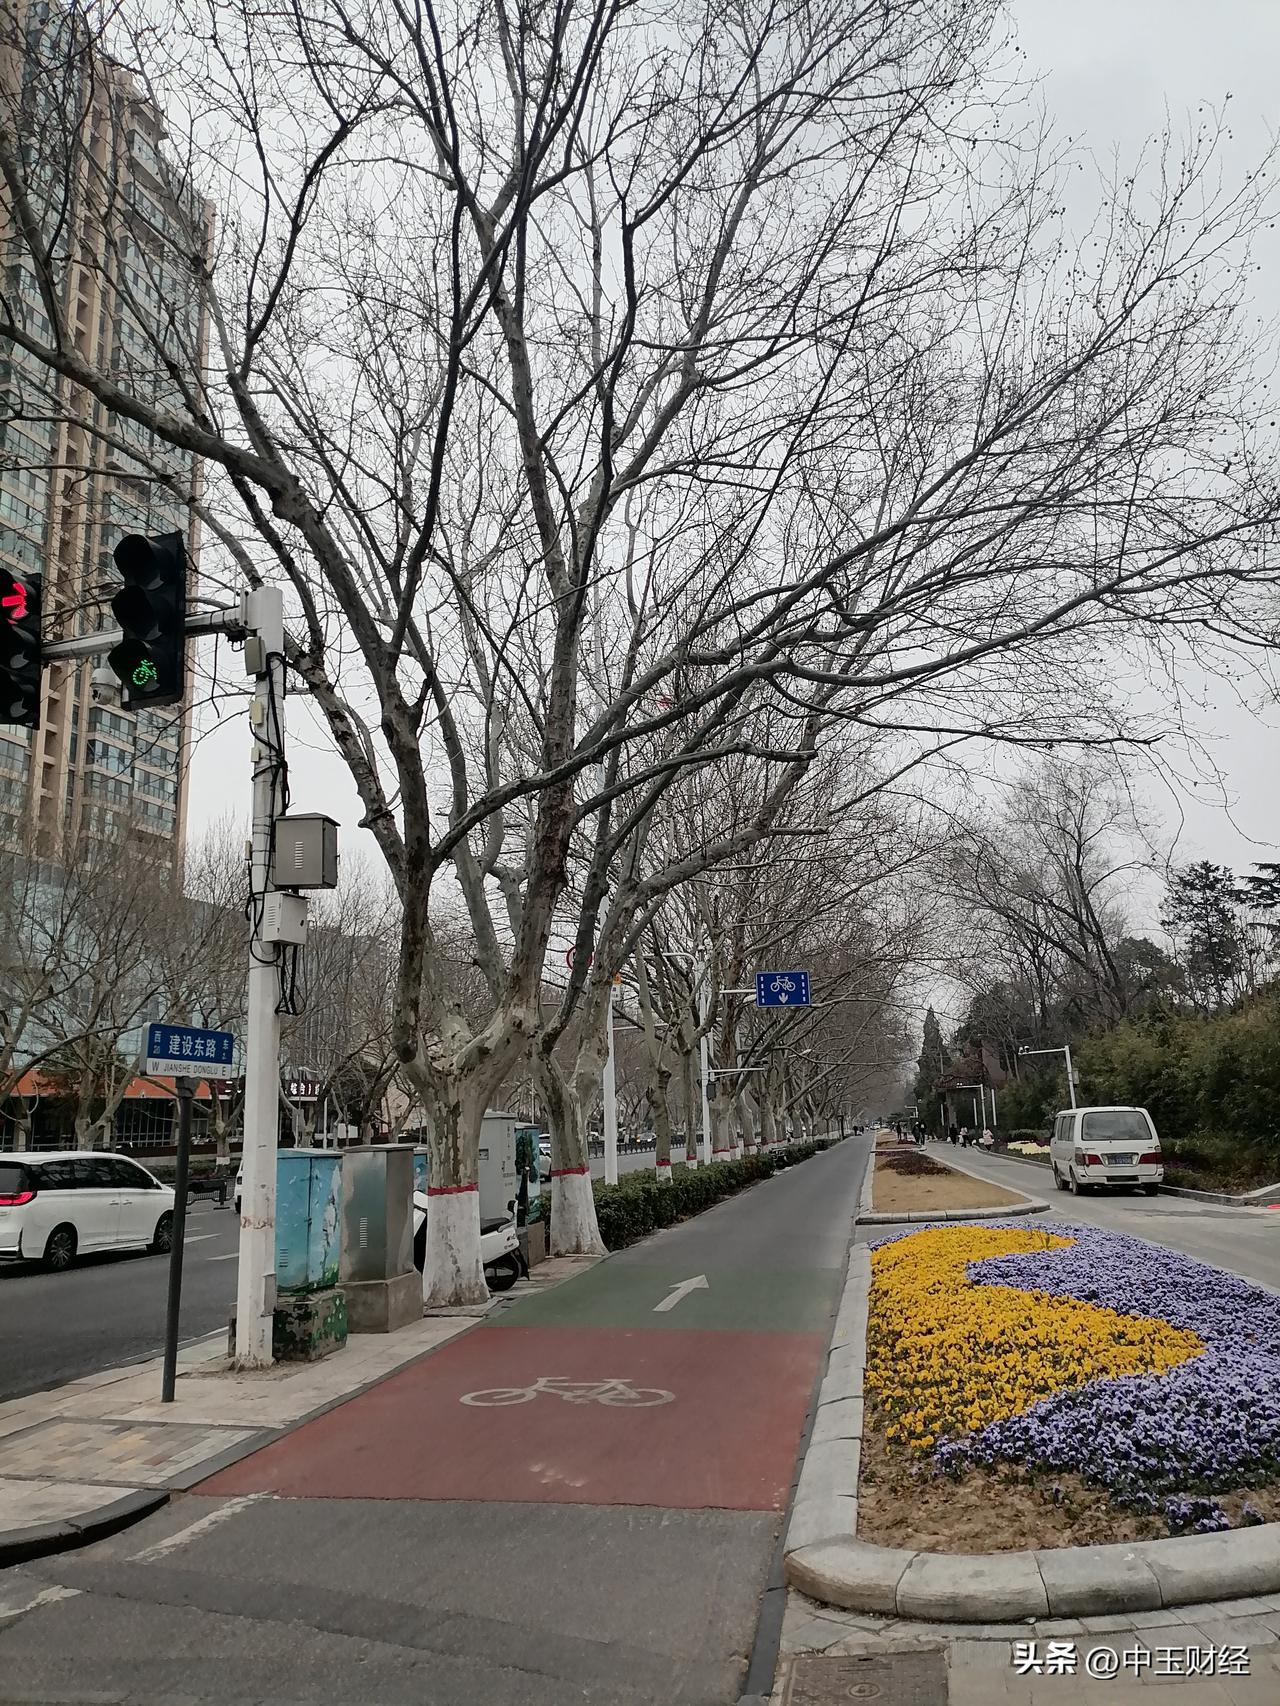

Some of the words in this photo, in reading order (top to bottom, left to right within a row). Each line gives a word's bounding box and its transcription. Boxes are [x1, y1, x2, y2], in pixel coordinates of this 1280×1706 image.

[168, 1033, 217, 1059] 建设东路
[151, 1062, 160, 1072] W
[163, 1063, 191, 1073] JIANSHE
[221, 1066, 227, 1076] E
